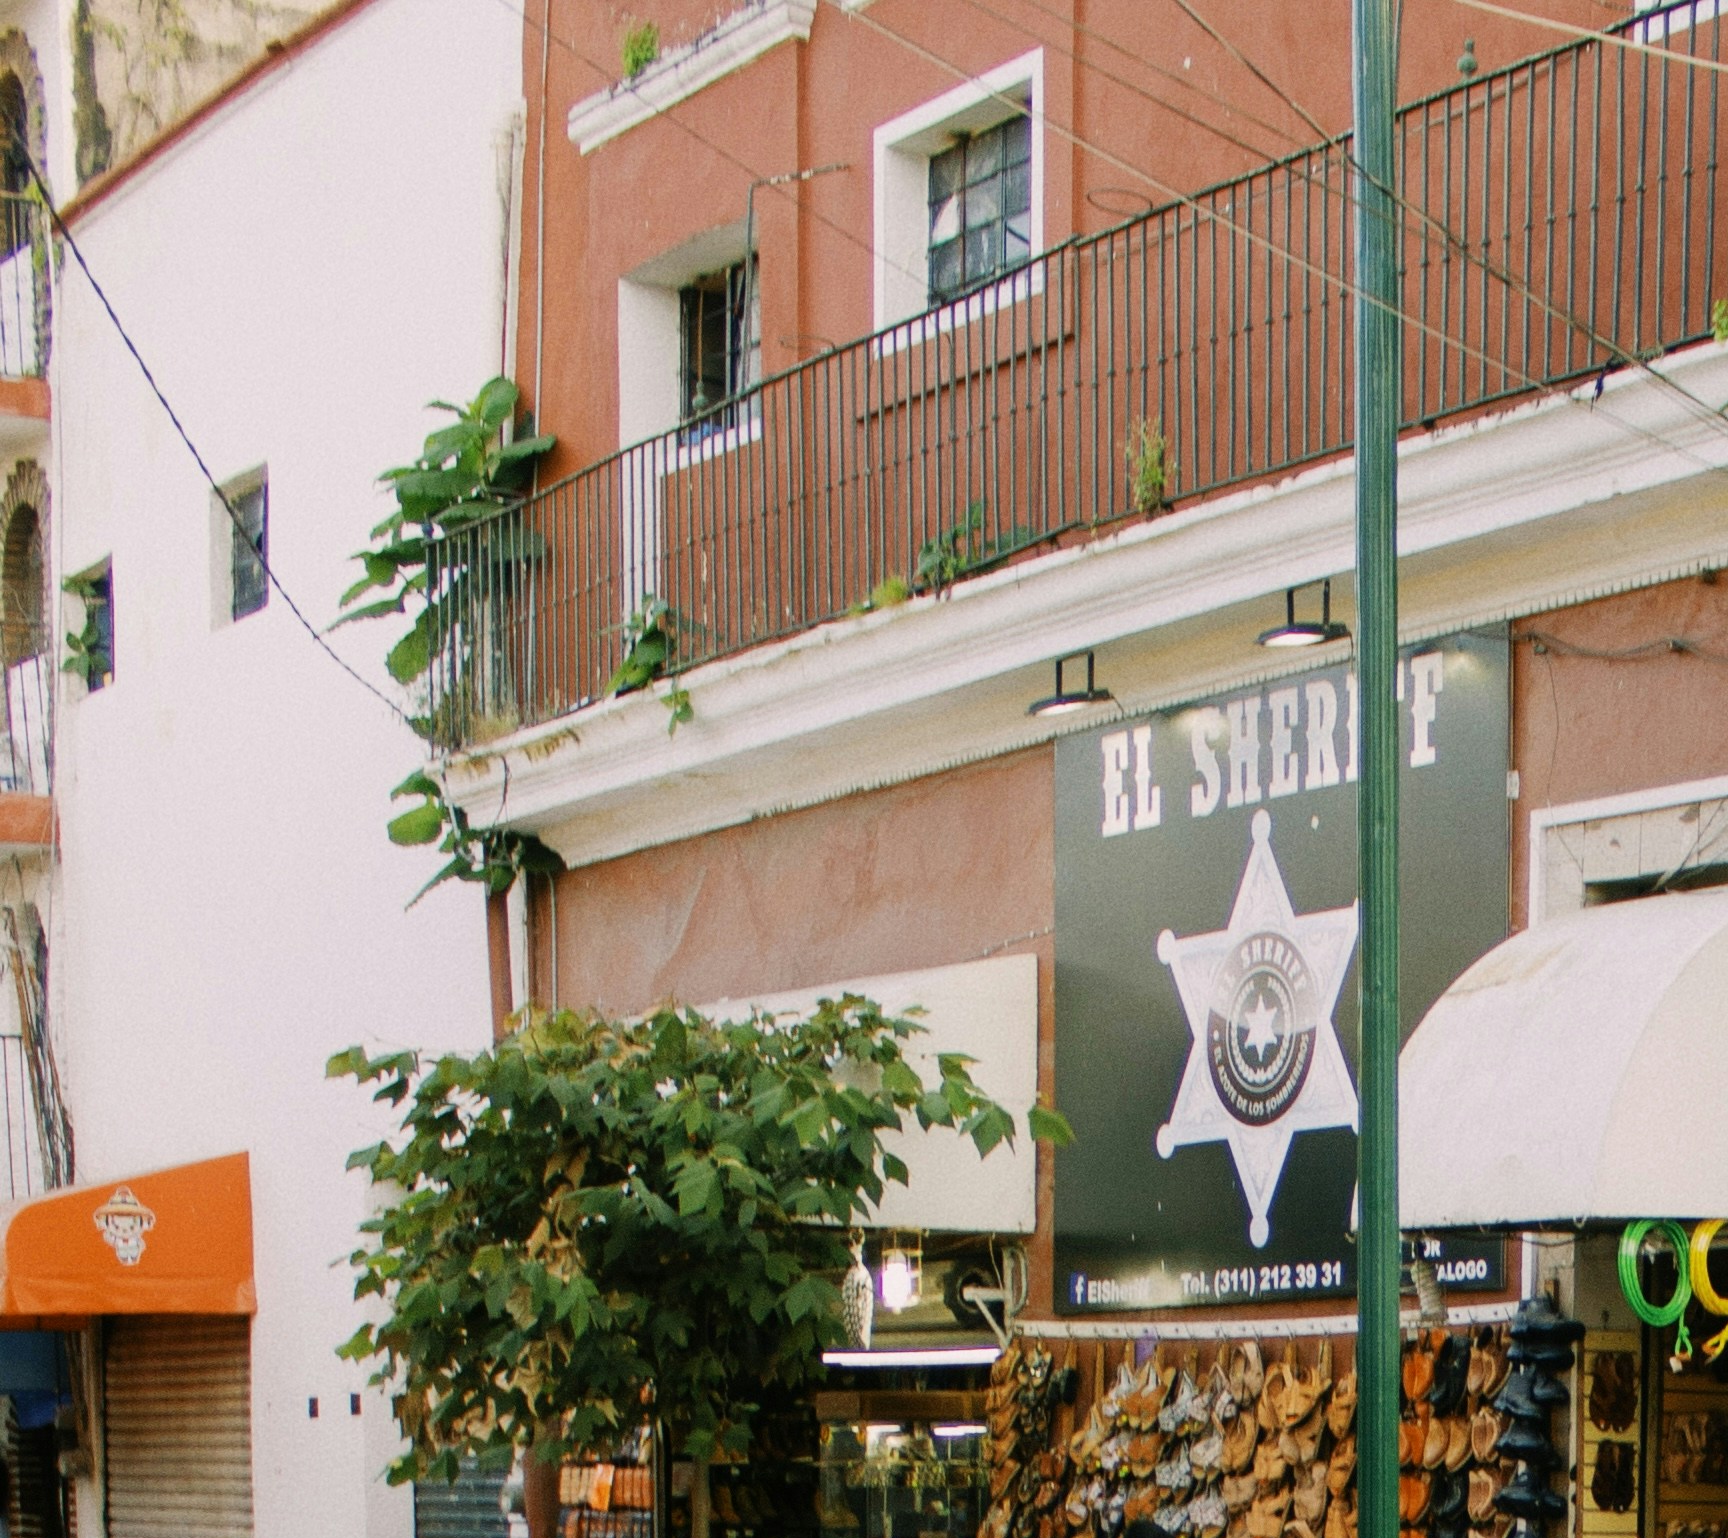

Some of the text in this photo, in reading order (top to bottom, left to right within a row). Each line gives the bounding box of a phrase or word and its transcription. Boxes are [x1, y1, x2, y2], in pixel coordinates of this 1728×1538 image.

[1102, 725, 1161, 838] EL
[1213, 1046, 1223, 1063] EL
[1236, 1096, 1248, 1113] DE
[1248, 1101, 1265, 1117] LOS
[1180, 1259, 1342, 1299] Tel. (311) 212 39 31
